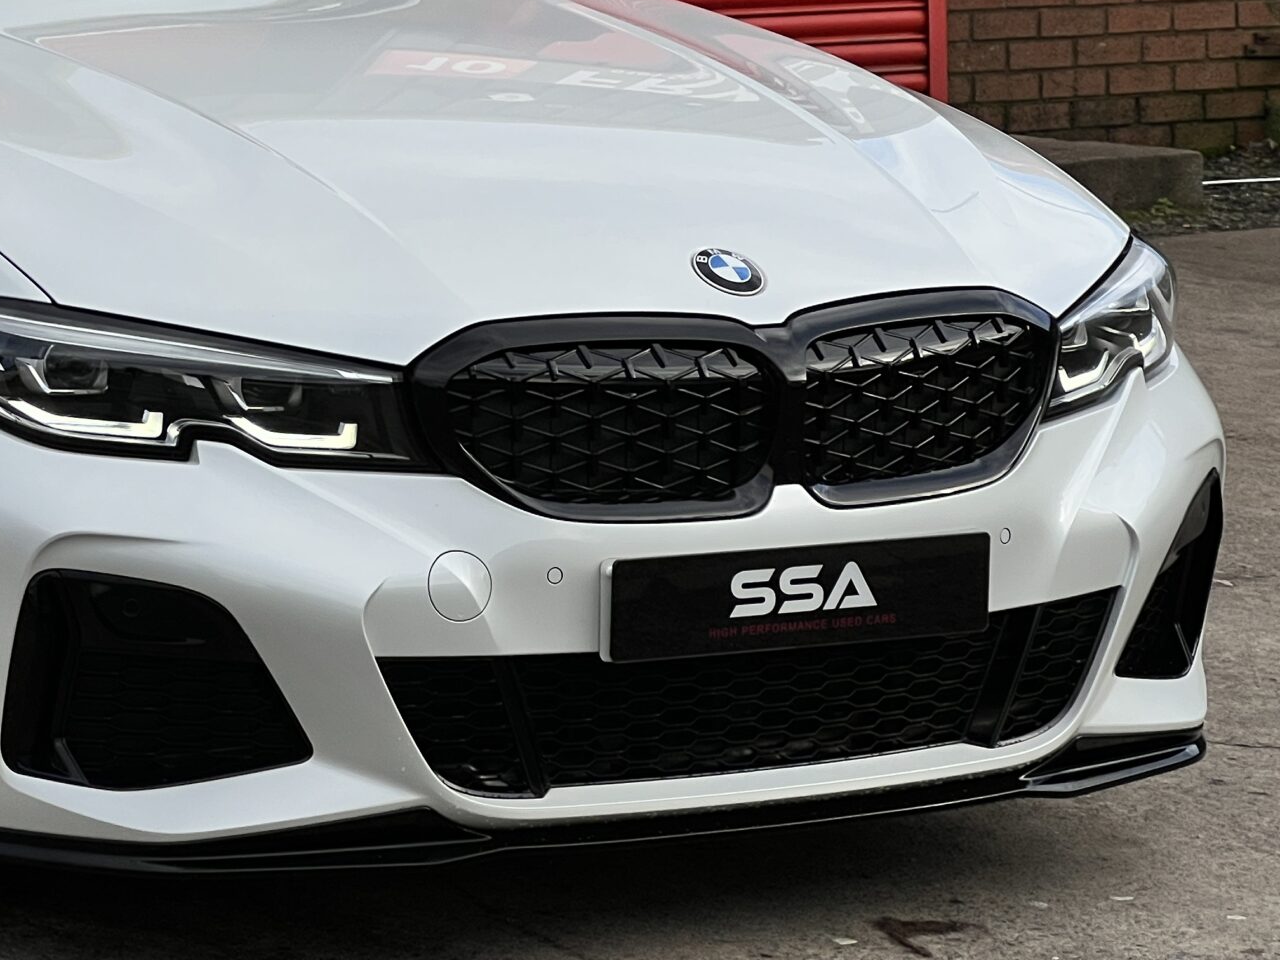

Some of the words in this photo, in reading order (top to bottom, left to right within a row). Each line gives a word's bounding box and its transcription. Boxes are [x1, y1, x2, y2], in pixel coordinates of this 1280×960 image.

[729, 561, 878, 618] SSA
[708, 626, 738, 640] HIGH
[741, 618, 828, 636] PERFORMANCE
[831, 615, 863, 628] USED
[865, 612, 897, 624] CARS
